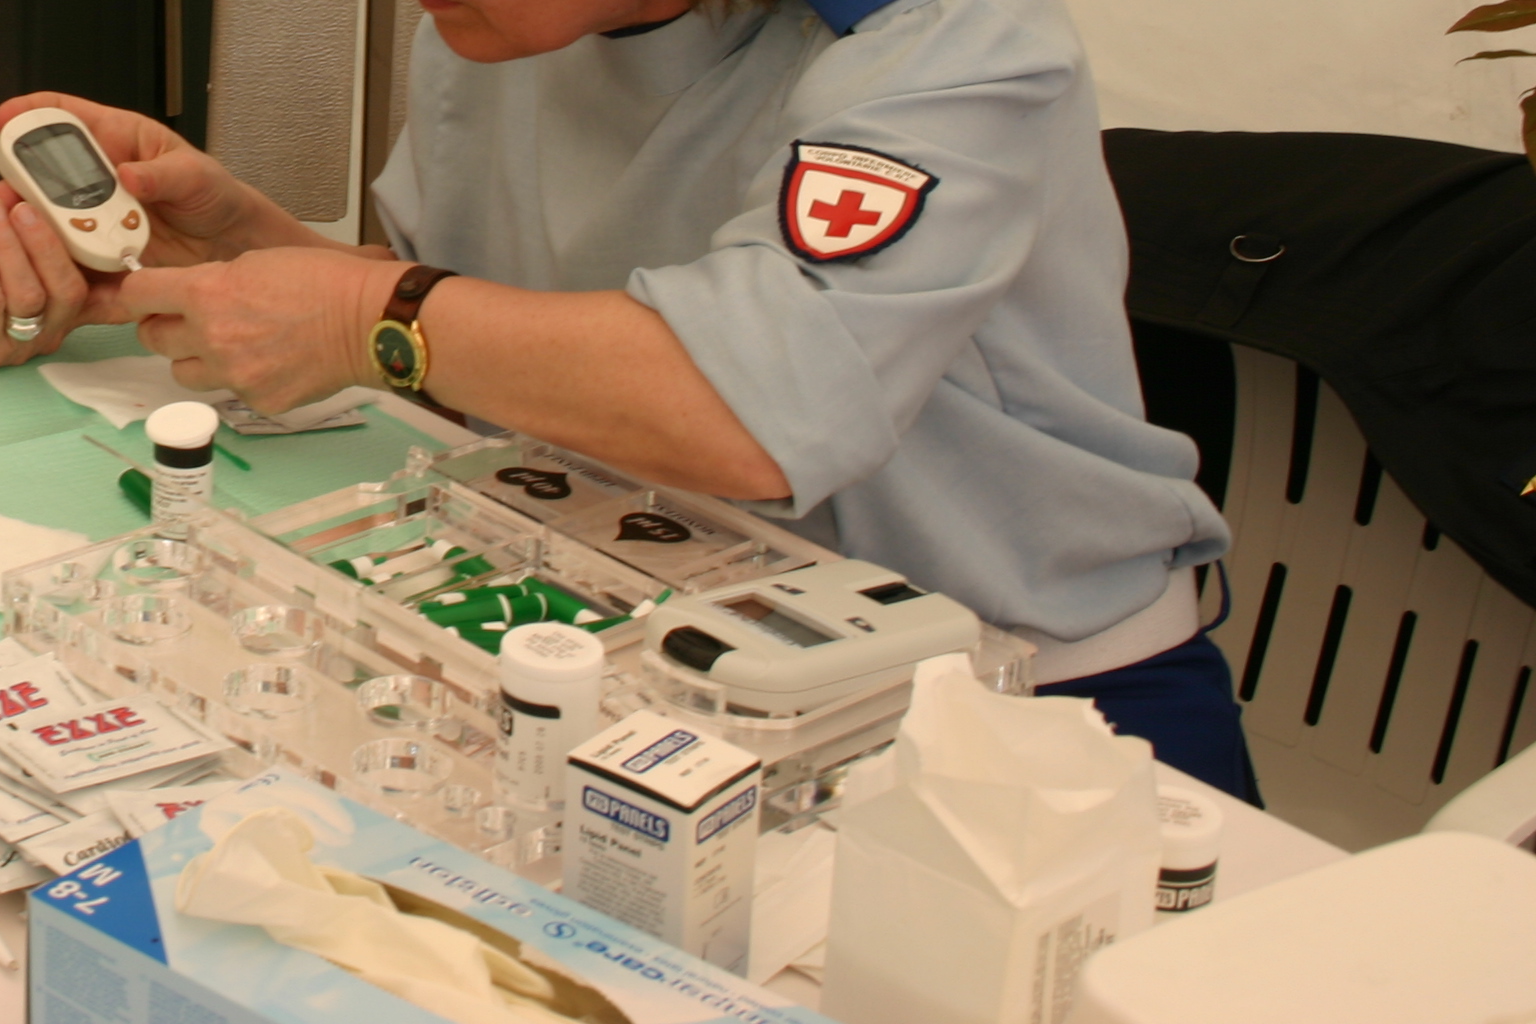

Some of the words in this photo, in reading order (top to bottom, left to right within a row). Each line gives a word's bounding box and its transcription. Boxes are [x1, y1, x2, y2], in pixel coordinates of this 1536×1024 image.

[31, 706, 147, 746] EXXE
[609, 798, 667, 840] PANELS
[76, 862, 124, 888] M
[47, 879, 111, 916] 7-8
